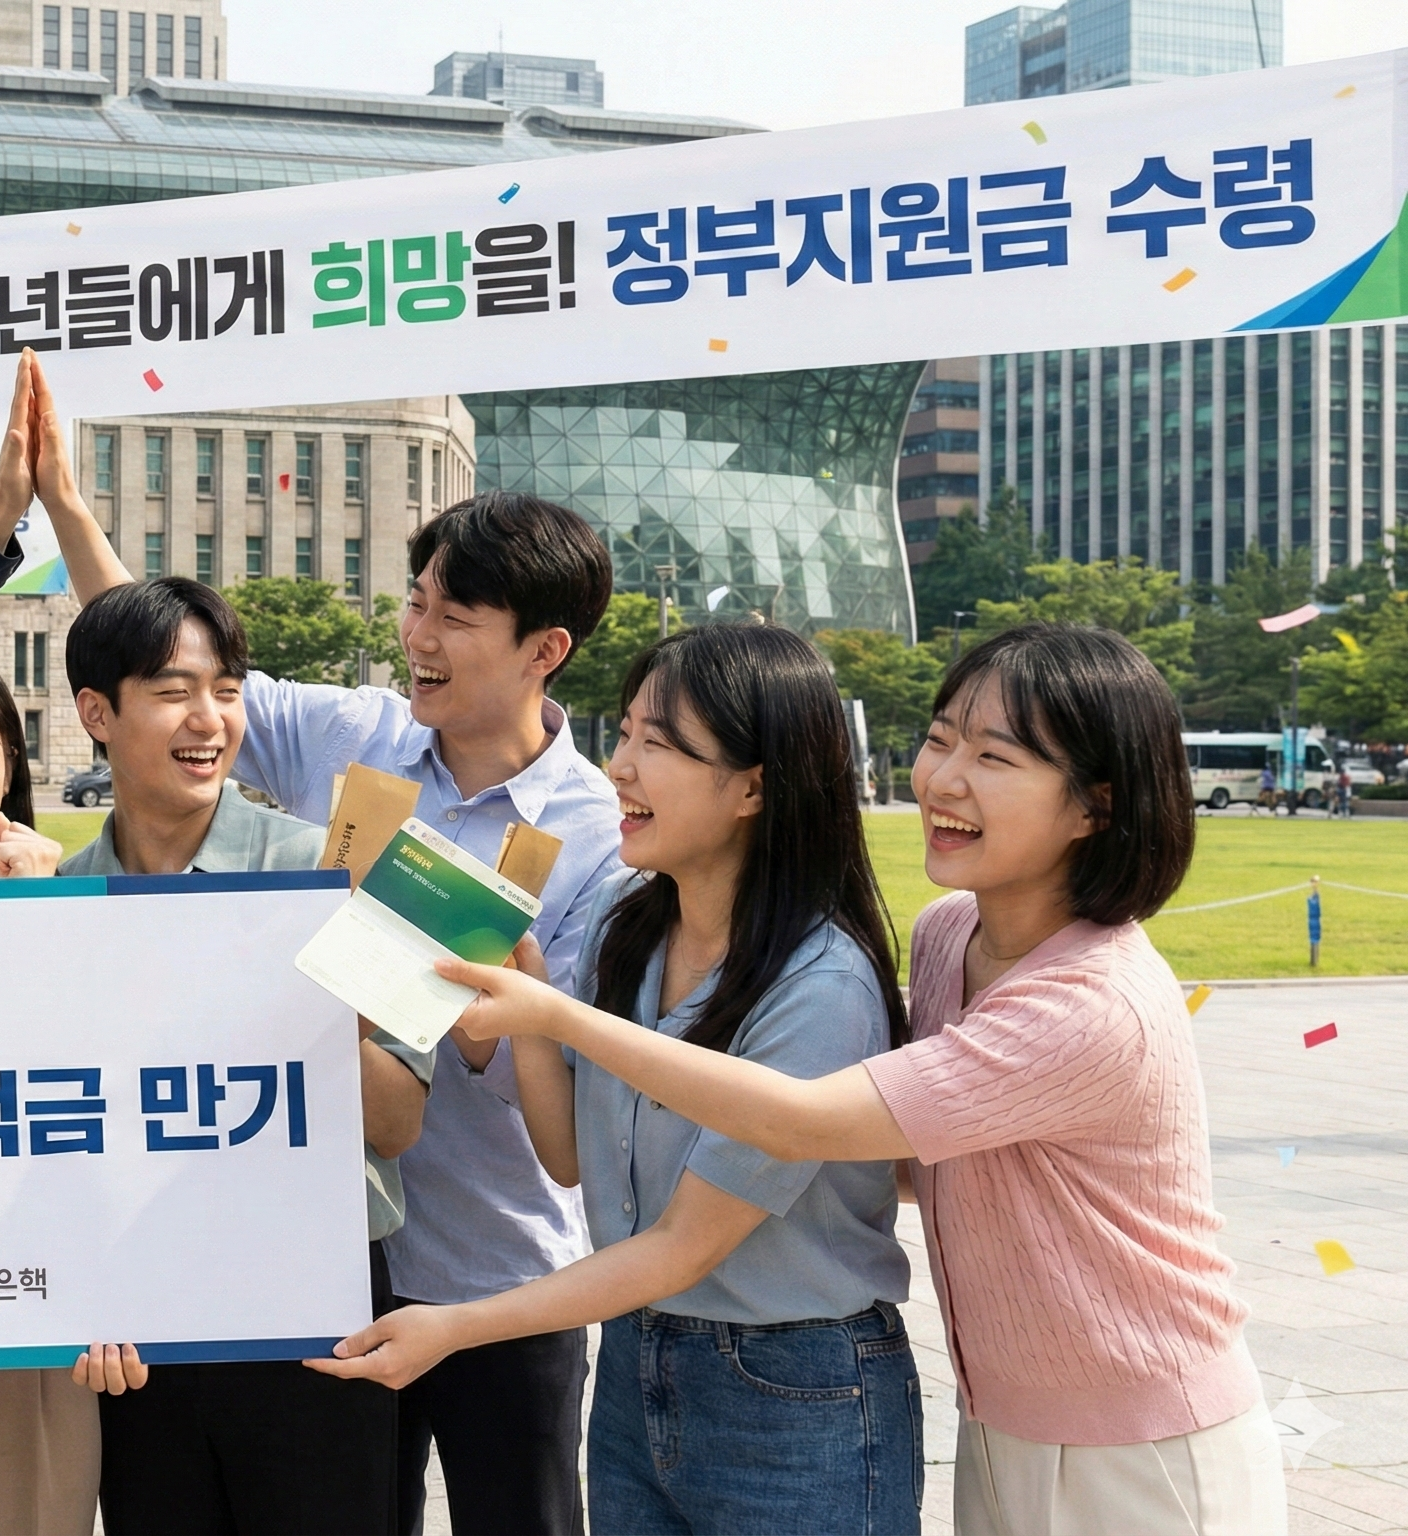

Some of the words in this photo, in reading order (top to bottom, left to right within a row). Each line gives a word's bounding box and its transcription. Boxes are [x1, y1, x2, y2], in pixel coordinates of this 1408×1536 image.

[311, 220, 577, 330] 희망을!
[606, 165, 1073, 307] 정부지원금
[1106, 138, 1317, 260] 수령
[139, 1060, 308, 1152] 만기
